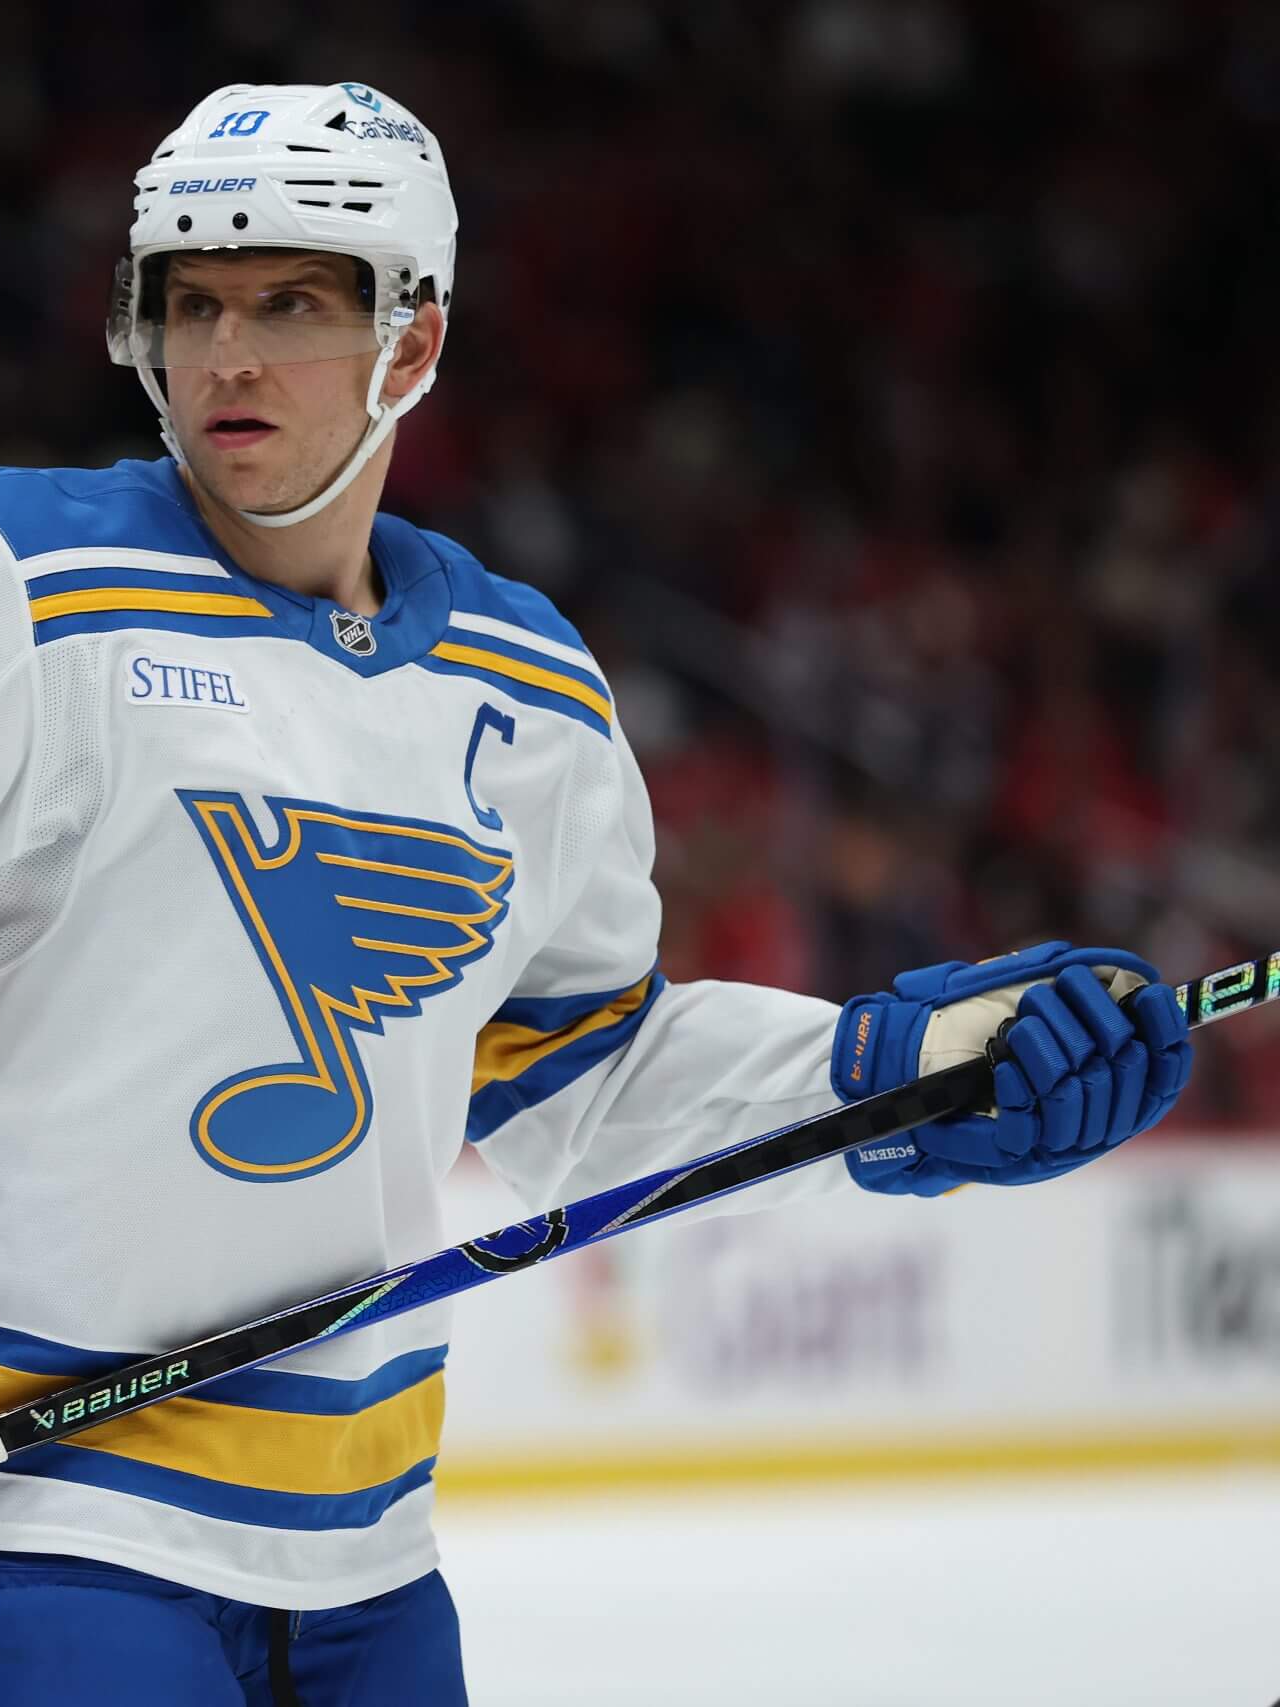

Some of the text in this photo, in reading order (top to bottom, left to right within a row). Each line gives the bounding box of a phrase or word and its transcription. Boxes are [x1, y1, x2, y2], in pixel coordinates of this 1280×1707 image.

[208, 111, 271, 138] 10
[344, 116, 425, 145] CarShield
[169, 177, 257, 194] BAUER
[342, 625, 364, 645] NHL
[131, 657, 246, 706] STIFEL
[464, 701, 516, 832] C
[61, 1359, 190, 1424] BAUER
